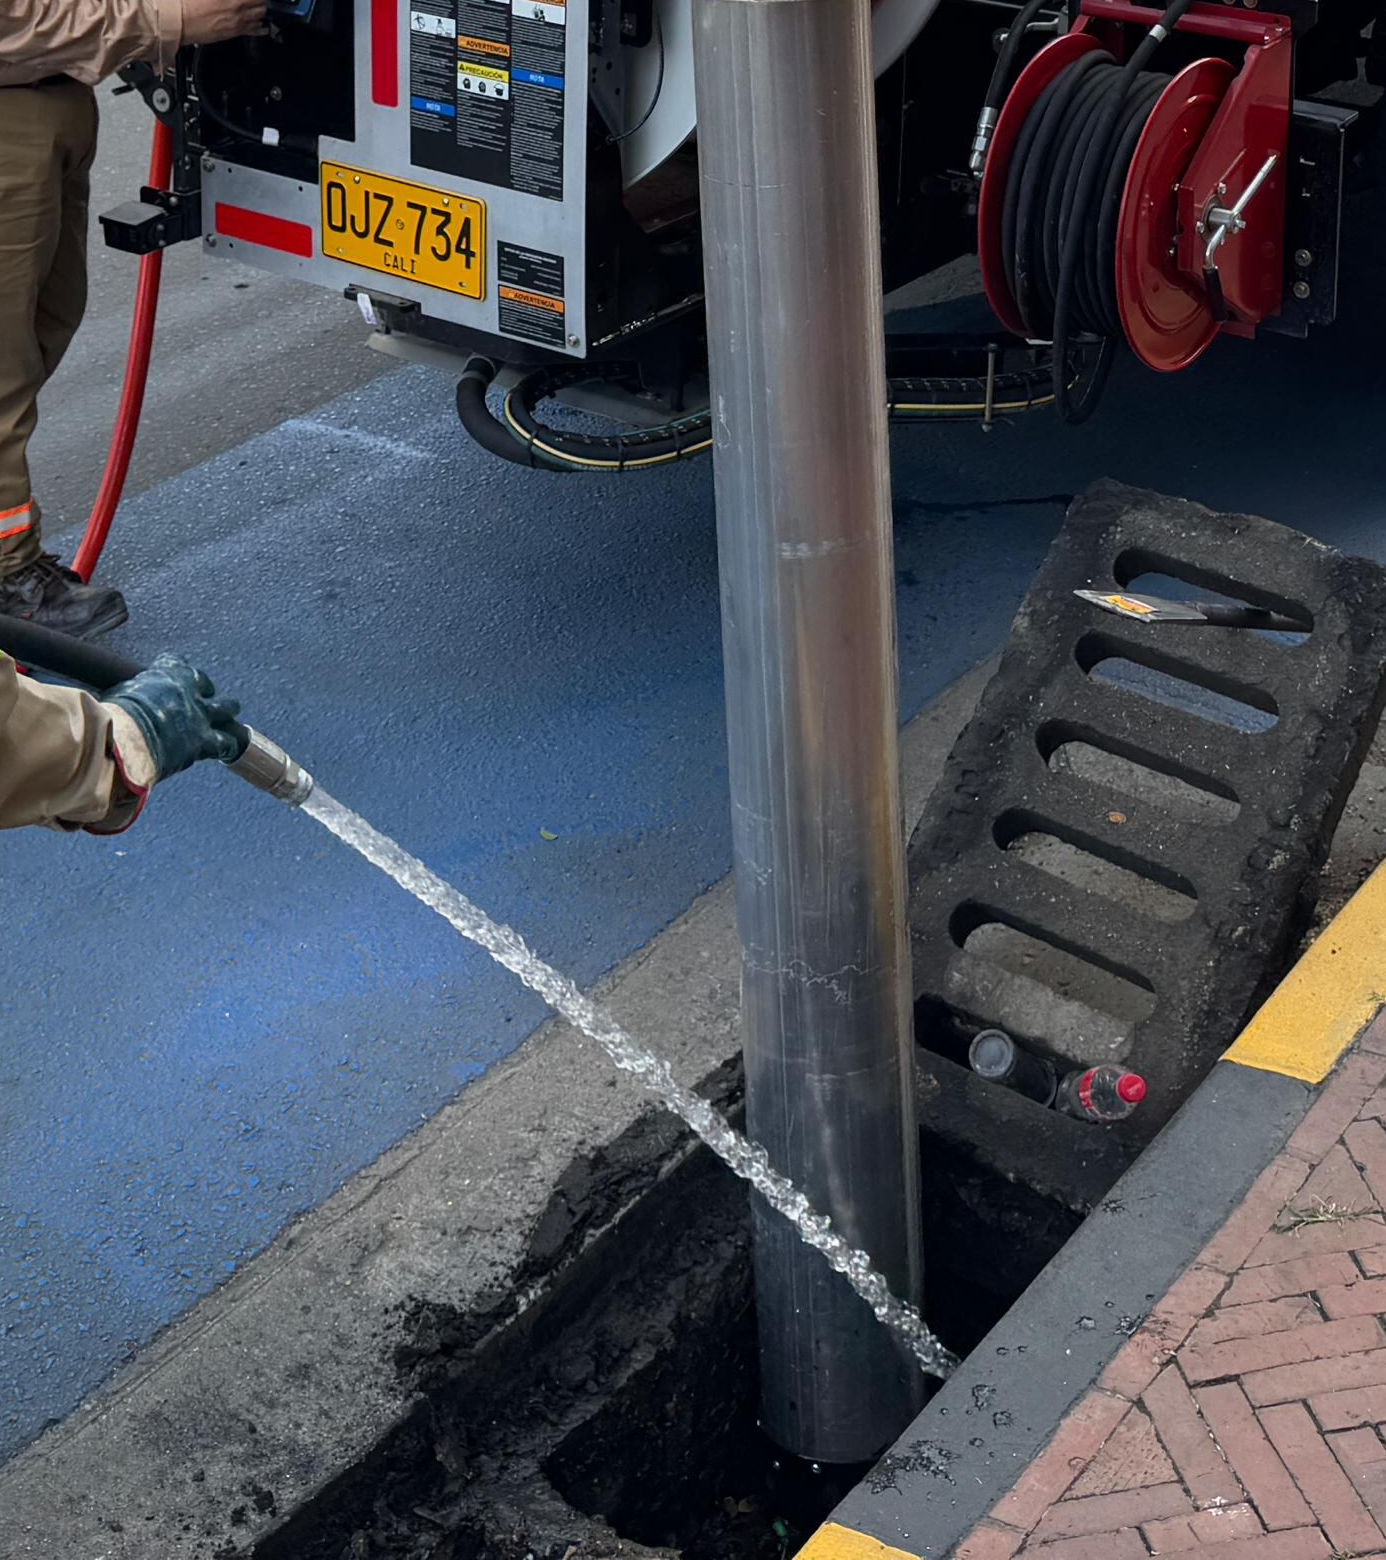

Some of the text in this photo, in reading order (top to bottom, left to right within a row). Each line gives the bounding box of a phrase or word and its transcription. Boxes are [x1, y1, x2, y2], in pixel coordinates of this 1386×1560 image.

[465, 40, 509, 55] ADVERTENCIA
[383, 252, 417, 275] CALI
[513, 292, 556, 309] ADVERTENCIA
